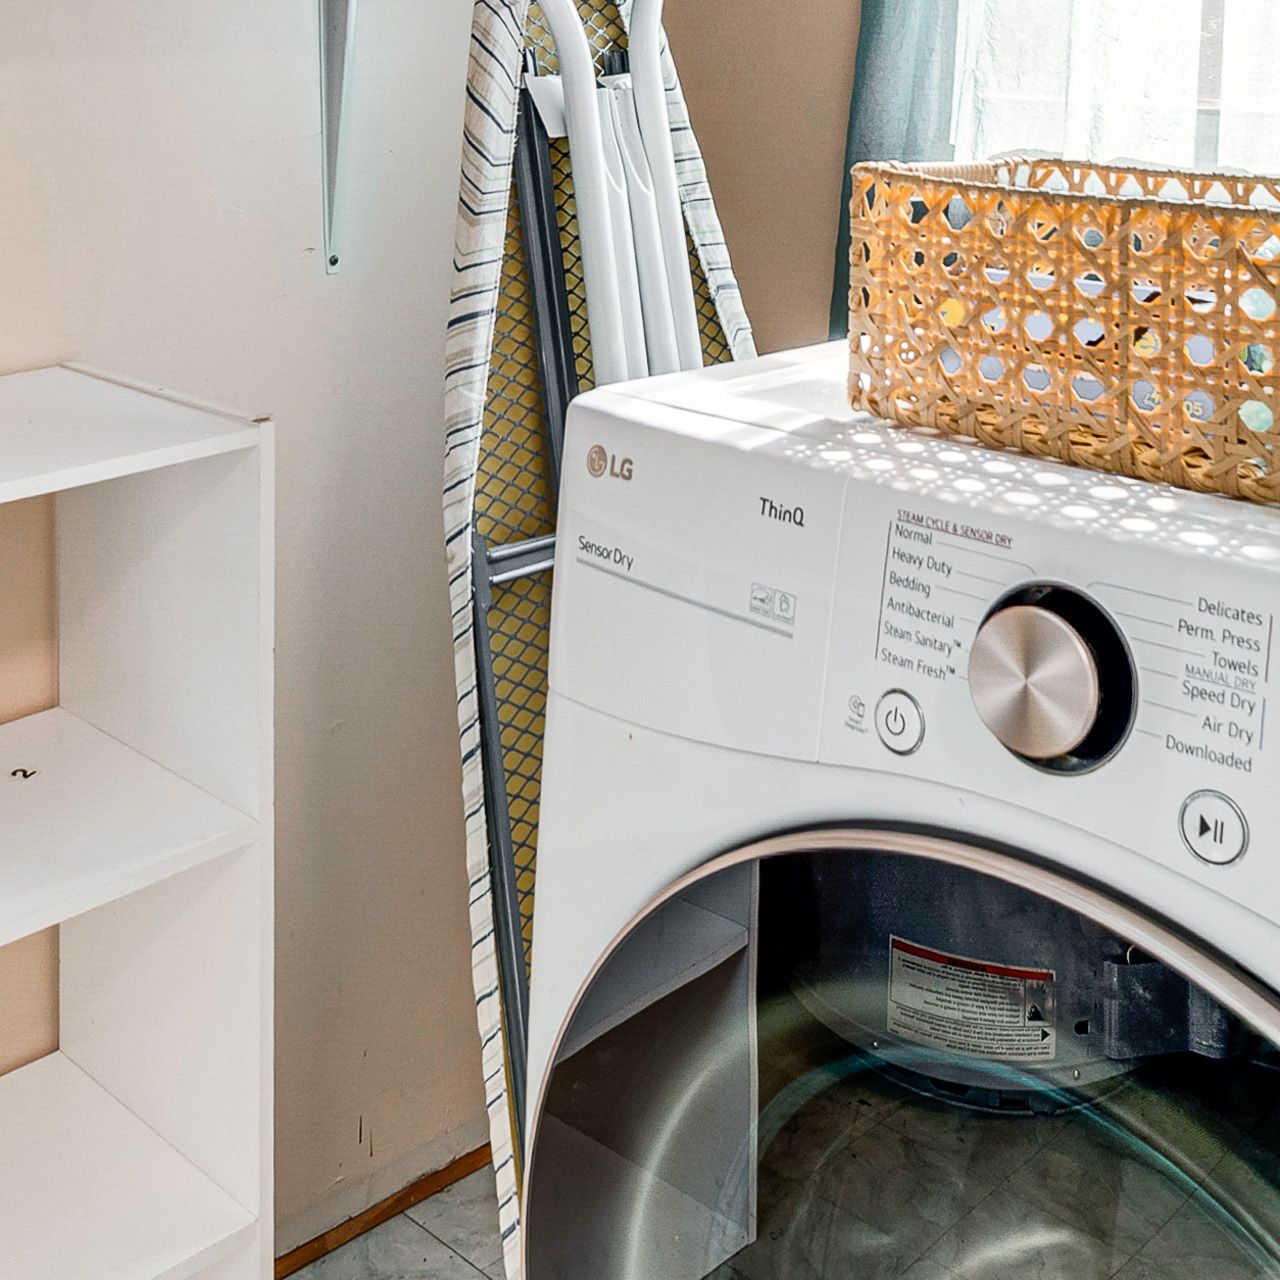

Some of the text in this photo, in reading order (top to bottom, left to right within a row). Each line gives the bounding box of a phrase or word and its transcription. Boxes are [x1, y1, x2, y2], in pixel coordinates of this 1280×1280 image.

[609, 454, 633, 481] LG
[759, 497, 805, 527] ThinQ
[895, 524, 933, 545] Normal
[897, 509, 1013, 546] STEAM CYCLE & SENSOR DRY
[892, 546, 952, 576] Heavy Duty
[889, 572, 931, 599] Bedding
[887, 597, 955, 628] Antibacterial
[1198, 597, 1263, 626] Delicates
[884, 622, 912, 642] Steam
[1178, 619, 1261, 652] Perm. Press
[881, 648, 914, 670] Steam
[1212, 651, 1259, 676] Towels
[1185, 663, 1256, 690] MANUAL DRY
[1182, 681, 1256, 715] Speed Dry
[1202, 716, 1254, 746] Air Dry
[1165, 734, 1253, 772] Downloaded
